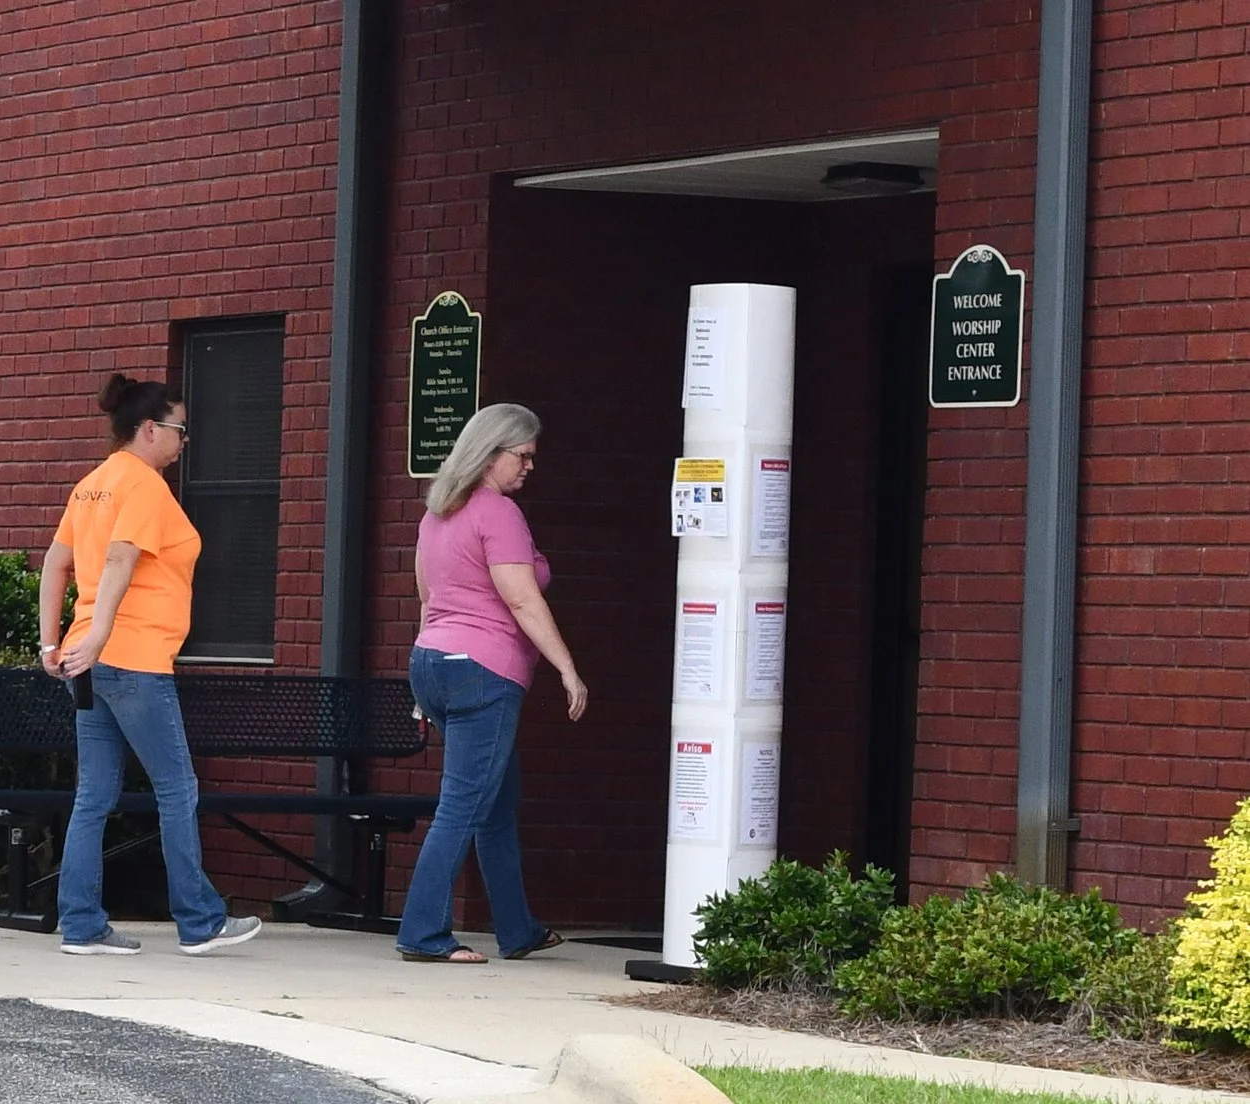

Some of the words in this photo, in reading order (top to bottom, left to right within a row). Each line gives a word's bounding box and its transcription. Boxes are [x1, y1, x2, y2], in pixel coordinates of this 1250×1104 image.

[953, 293, 1002, 309] WELCOME
[421, 326, 437, 336] Church
[952, 319, 1002, 336] WORSHIP
[955, 342, 995, 359] CENTER
[947, 364, 1002, 381] ENTRANCE
[683, 743, 703, 753] Aviso
